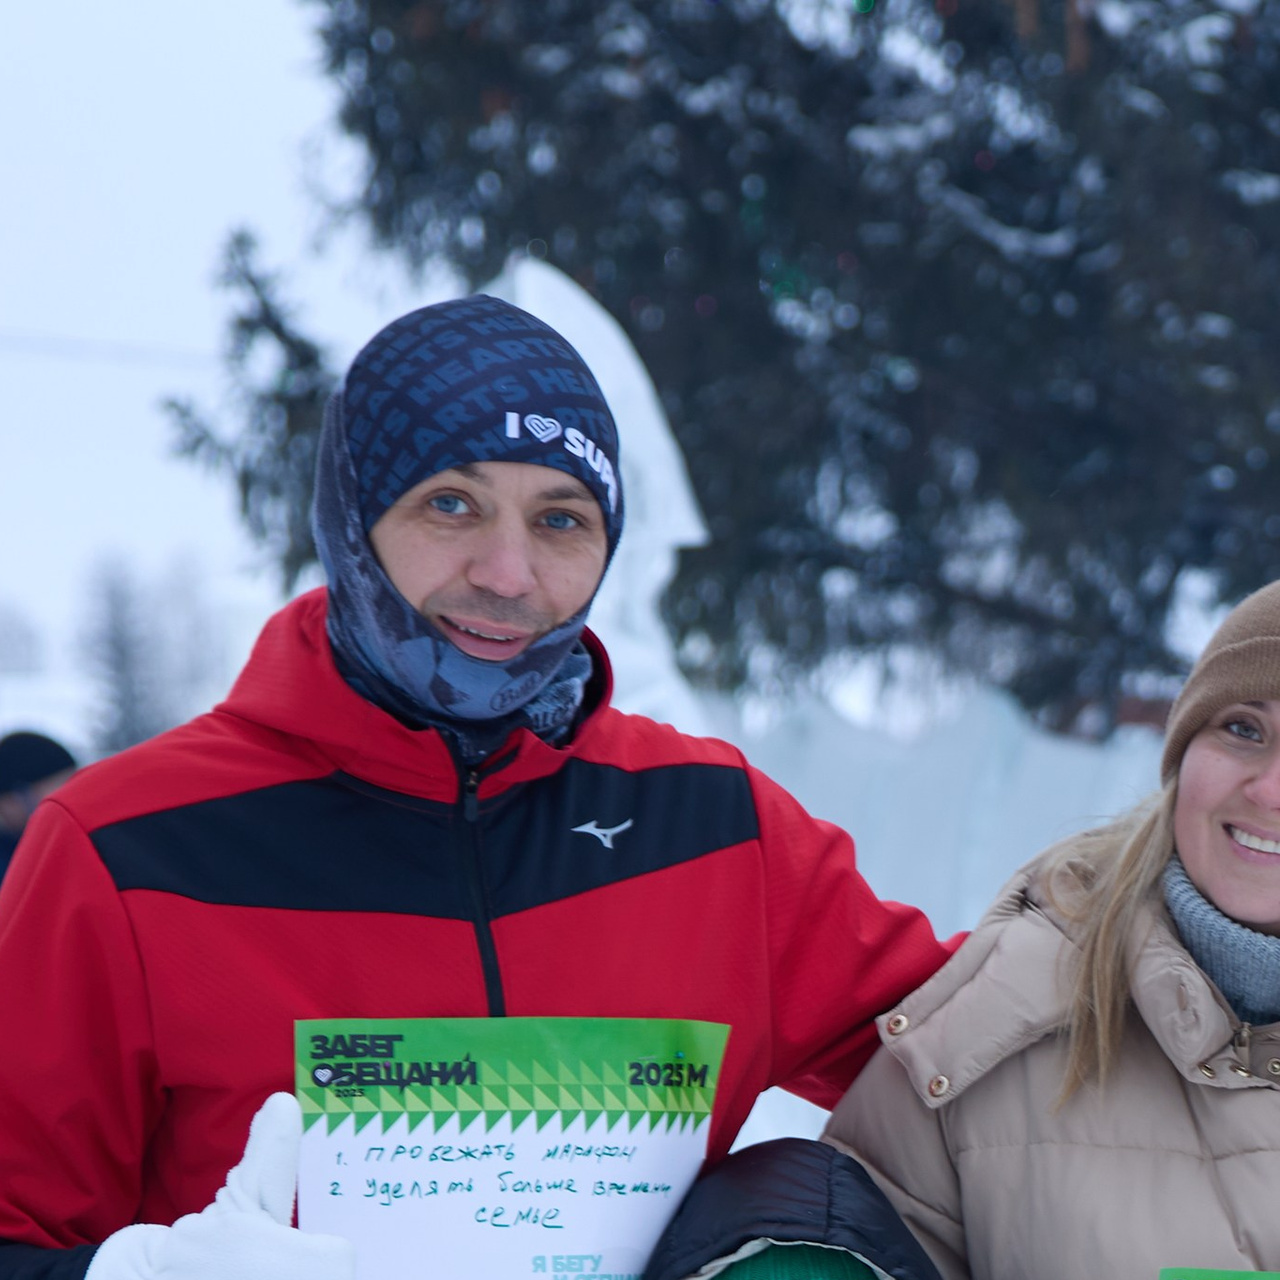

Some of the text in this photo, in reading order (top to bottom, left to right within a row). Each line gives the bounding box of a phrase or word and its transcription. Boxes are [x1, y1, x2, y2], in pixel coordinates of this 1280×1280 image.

[505, 411, 520, 439] I
[310, 1034, 403, 1059] ЗАБЕГ
[312, 1052, 477, 1094] ОБЕЩАНИЙ
[628, 1062, 684, 1087] 2025
[335, 1088, 365, 1097] 2025
[532, 1254, 603, 1273] Я БЕГУ
